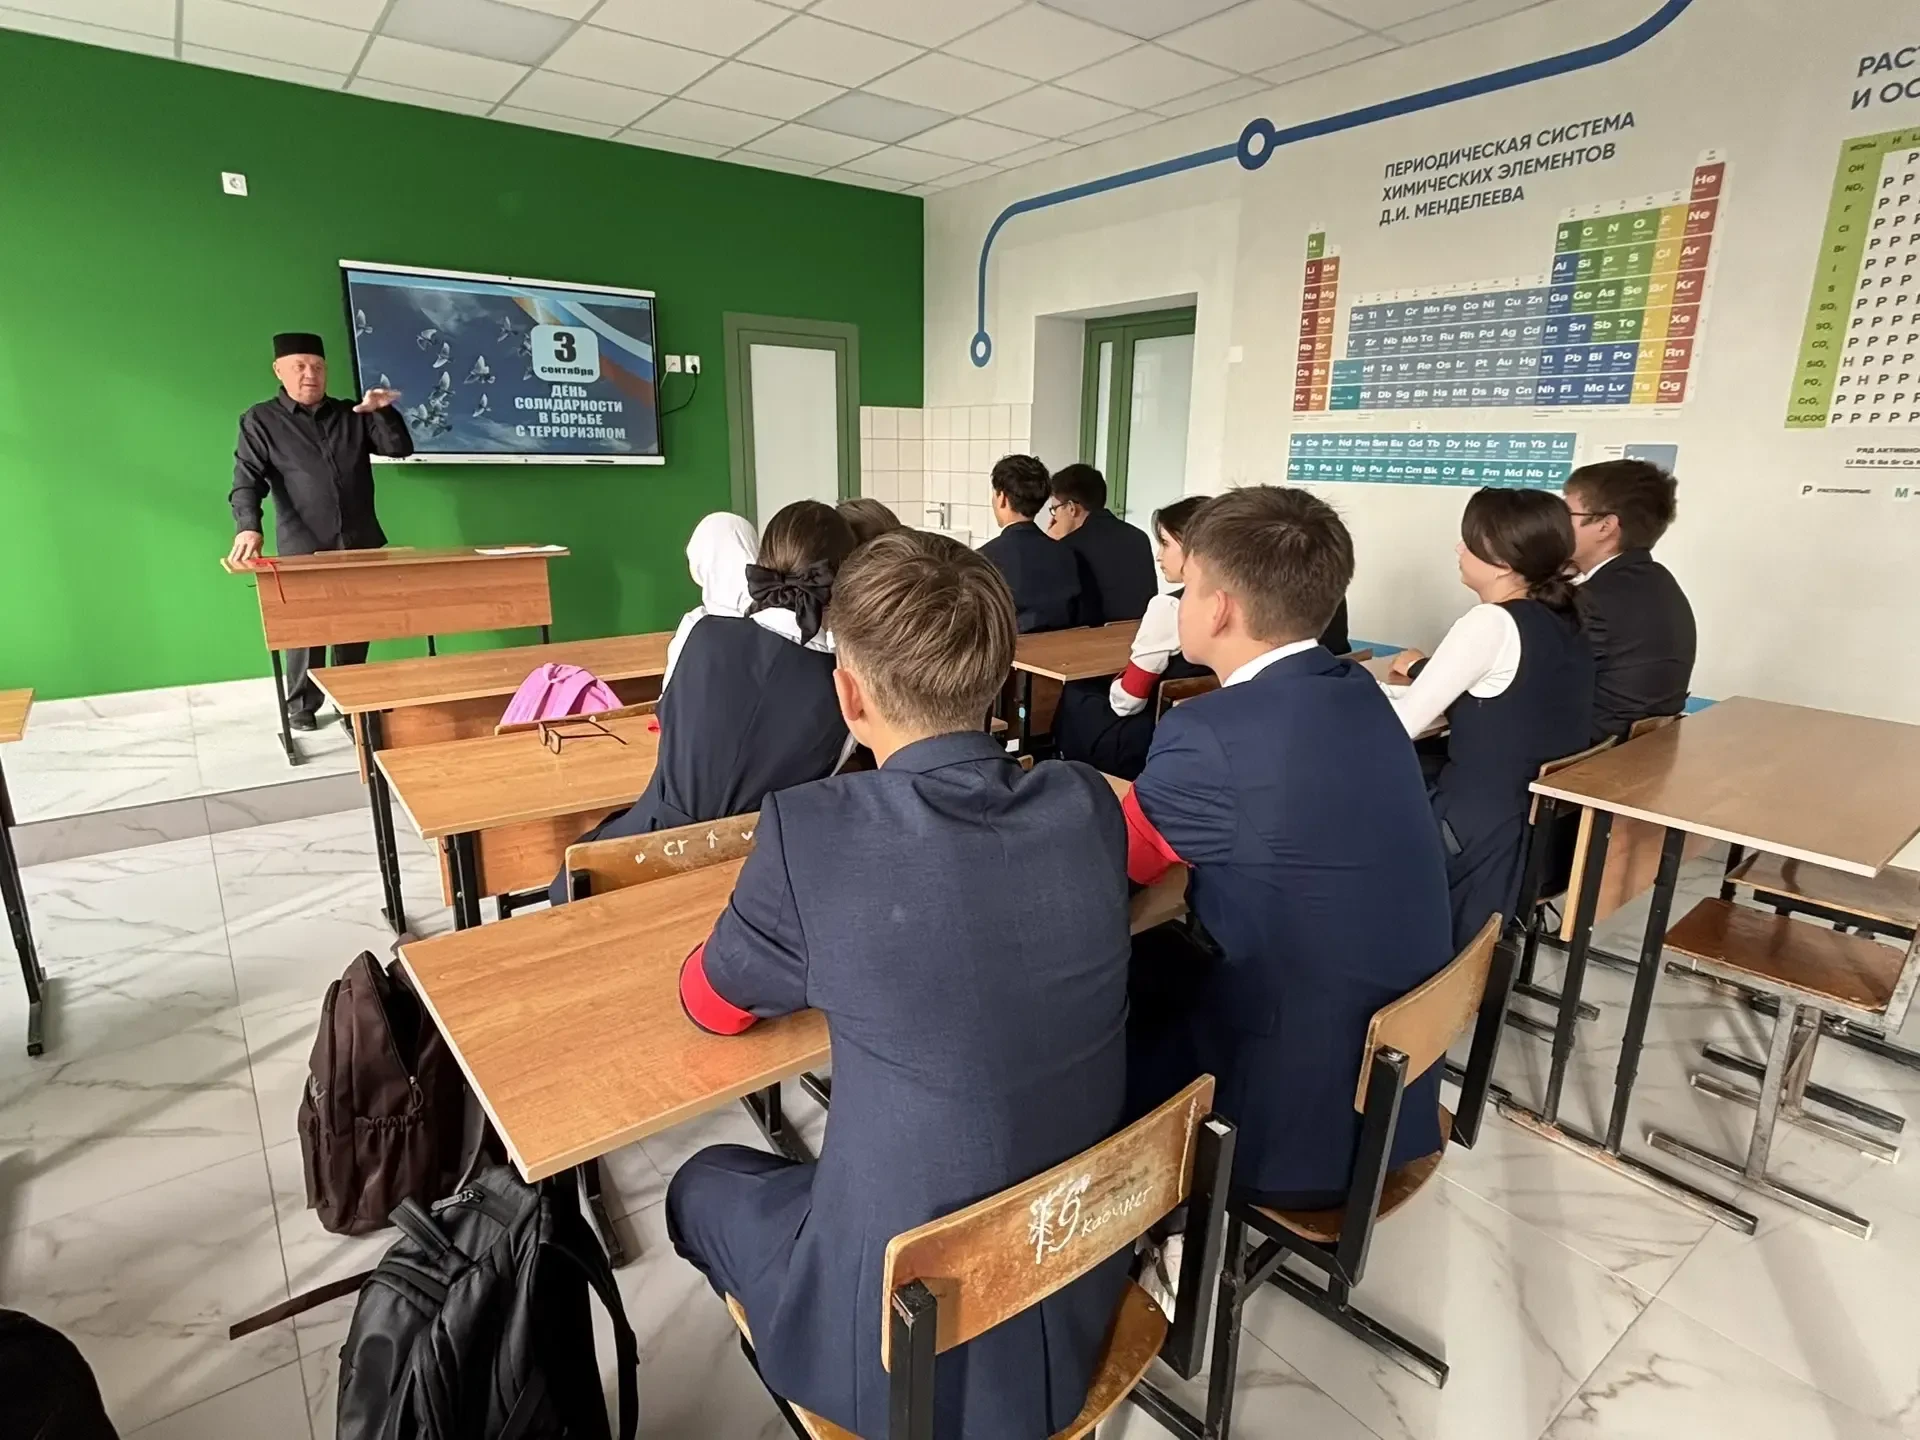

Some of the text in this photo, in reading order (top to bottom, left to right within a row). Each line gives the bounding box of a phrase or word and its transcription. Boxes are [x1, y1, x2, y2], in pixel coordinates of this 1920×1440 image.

[1857, 46, 1920, 78] РАС
[1851, 88, 1872, 110] И
[1385, 111, 1636, 178] ПЕРИОДИЧЕСКАЯ СИСТЕМА
[1382, 143, 1616, 201] ХИМИЧЕСКИХ ЭЛЕМЕНТОВ
[1695, 175, 1716, 185] He
[1883, 174, 1914, 188] Р Р
[1379, 186, 1525, 226] Д.И. МЕНДЕЛЕЕВА
[1878, 195, 1910, 209] Р Р
[1559, 211, 1710, 239] B C N O Ne
[1874, 215, 1905, 229] Р Р
[1869, 238, 1881, 249] Р
[1889, 236, 1900, 247] Р
[1554, 246, 1699, 270] Al Si P S Ar
[1865, 254, 1916, 270] Р Р Р
[1861, 275, 1912, 290] Р Р Р
[1527, 296, 1542, 304] Zn
[1550, 294, 1568, 302] Ga
[1573, 291, 1592, 300] Ge
[1597, 289, 1615, 297] As
[1623, 287, 1642, 295] Se
[1677, 280, 1695, 289] Kr
[1857, 295, 1907, 309] Р Р Р
[1501, 329, 1516, 337] Ag
[1569, 323, 1586, 331] Sn
[1593, 321, 1612, 329] Sb
[1619, 320, 1635, 328] Te
[1671, 315, 1690, 324] Xe
[1852, 318, 1863, 329] Р
[1871, 317, 1883, 327] Р
[1891, 315, 1903, 326] Р
[553, 331, 577, 363] 3
[1848, 338, 1858, 348] Р
[1867, 336, 1878, 347] Р
[1887, 335, 1898, 346] Р
[1497, 358, 1512, 366] Au
[1520, 357, 1536, 366] Hg
[1564, 354, 1582, 362] Pb
[1589, 353, 1602, 361] Bi
[1613, 351, 1632, 359] Po
[1665, 348, 1684, 357] Rn
[1863, 355, 1874, 366] Р
[1882, 354, 1894, 365] Р
[1902, 354, 1914, 364] Р
[540, 365, 594, 377] сентября
[1840, 376, 1851, 386] Р
[1878, 374, 1889, 385] Р
[1898, 373, 1909, 384] Р
[551, 385, 587, 398] ДЕНЬ
[1396, 391, 1409, 399] Sg
[1493, 388, 1509, 396] Rg
[1584, 384, 1604, 392] Mc
[1608, 383, 1625, 391] Lv
[1660, 381, 1680, 391] Og
[514, 397, 623, 413] СОЛИДАРНОСТИ
[1836, 395, 1846, 405] Р
[1854, 394, 1865, 404] Р
[1873, 393, 1884, 404] Р
[1893, 393, 1904, 404] Р
[539, 412, 603, 425] В БОРЬБЕ
[1832, 413, 1900, 423] Р Р Р Р
[515, 425, 626, 439] С ТЕРРОРИЗМОМ
[1446, 440, 1460, 449] Dy
[1483, 468, 1499, 476] Fm
[1504, 469, 1522, 477] Md
[1802, 486, 1812, 494] Р
